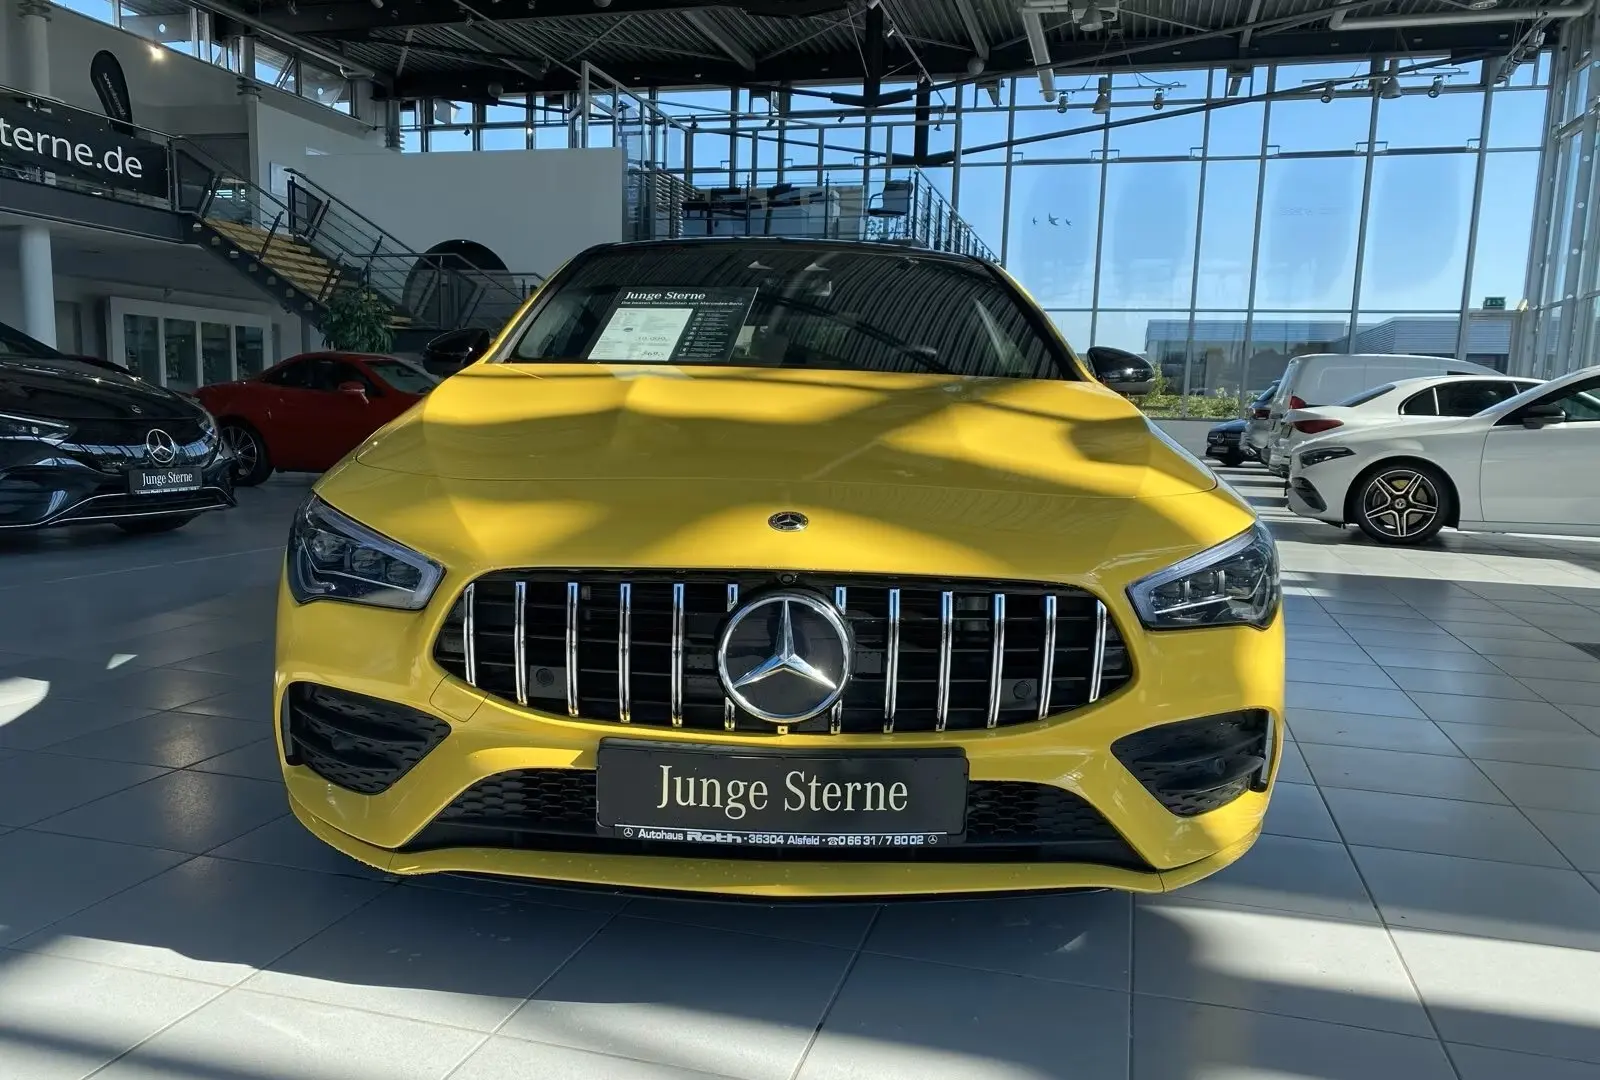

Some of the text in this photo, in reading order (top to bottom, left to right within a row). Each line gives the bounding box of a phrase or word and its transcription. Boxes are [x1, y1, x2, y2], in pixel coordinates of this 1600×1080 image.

[0, 117, 142, 178] terne.de
[624, 291, 706, 301] Junge Sterne
[142, 471, 193, 486] Junge Sterne
[657, 764, 908, 820] Junge Sterne
[637, 828, 684, 841] Autohaus
[686, 831, 742, 844] Roth
[748, 833, 785, 845] 36304
[786, 834, 820, 846] Alsfeld
